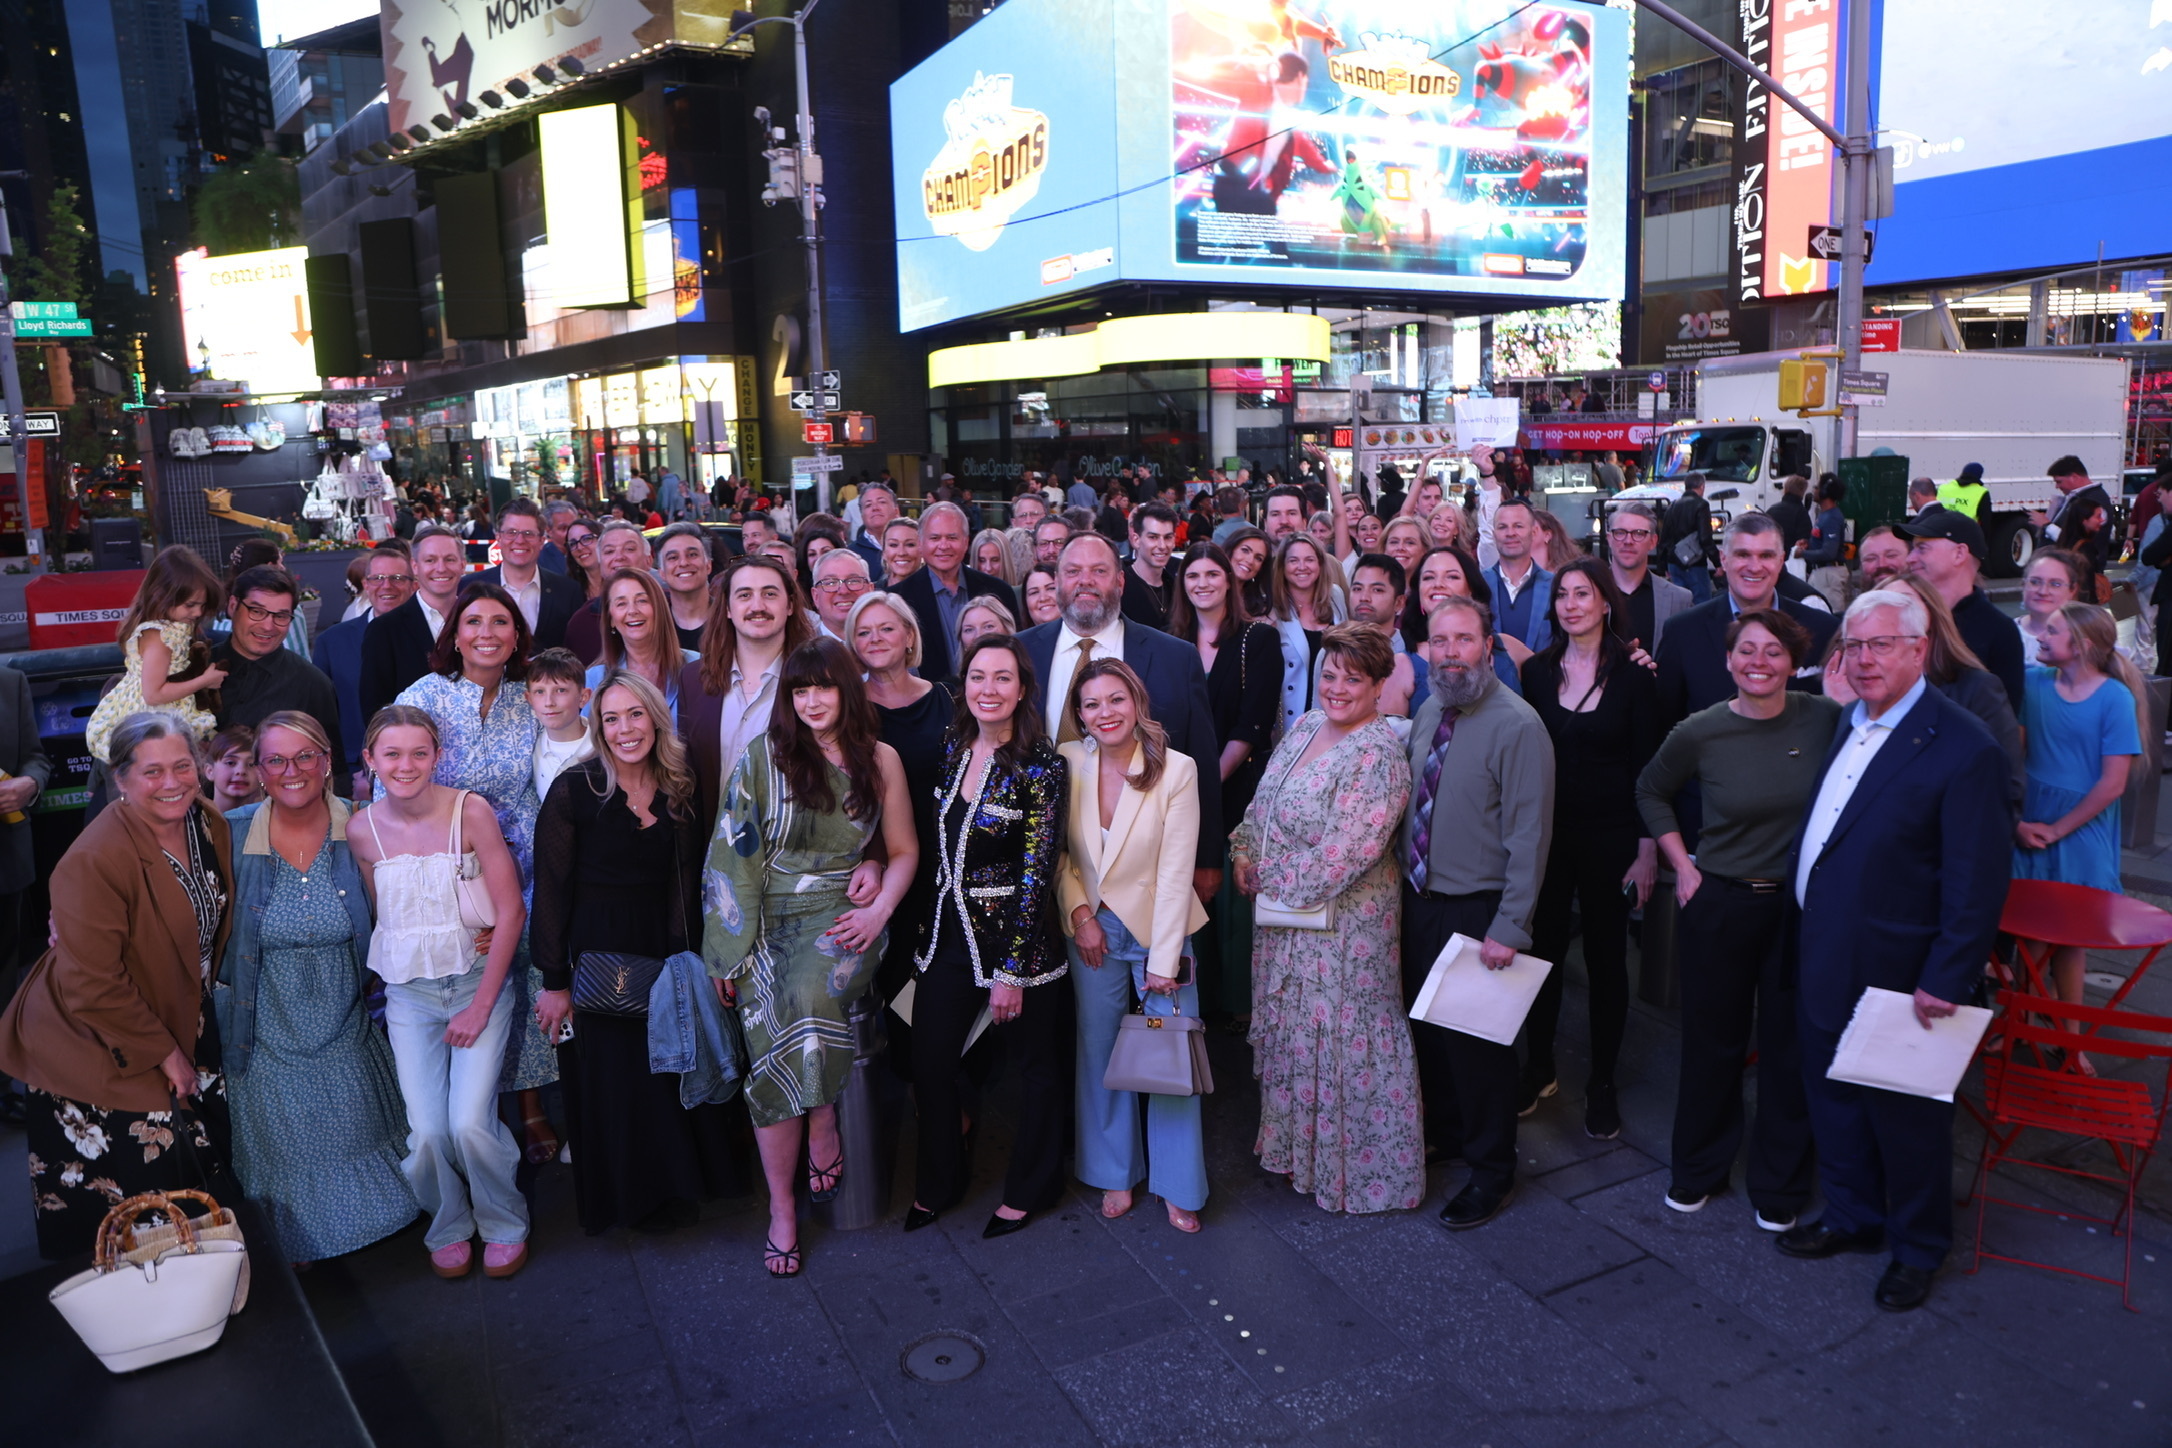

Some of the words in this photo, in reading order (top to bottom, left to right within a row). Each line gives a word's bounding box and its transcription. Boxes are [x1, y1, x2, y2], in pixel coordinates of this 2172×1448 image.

[1331, 61, 1458, 95] CHAMPIONS
[1780, 22, 1828, 171] INSIDE!
[924, 122, 1044, 214] CHAMPIONS
[1818, 237, 1836, 250] ONE
[210, 267, 265, 286] come
[270, 262, 293, 279] in
[27, 305, 39, 316] W
[45, 305, 60, 316] 47
[18, 321, 44, 331] Lloyd
[48, 321, 87, 330] Richards
[741, 359, 752, 416] CHANGE
[1843, 379, 1860, 387] Times
[1861, 379, 1881, 389] Square
[799, 395, 812, 405] ONE
[28, 420, 49, 429] WAY
[1335, 429, 1353, 447] HOT
[1528, 430, 1543, 438] GET
[744, 424, 755, 471] MONEY
[962, 457, 987, 476] Olive
[988, 458, 1025, 481] Garden
[1079, 455, 1112, 477] Olive
[491, 549, 503, 561] ST
[55, 611, 98, 622] TIMES
[67, 757, 79, 765] GO
[68, 763, 91, 773] TSQ
